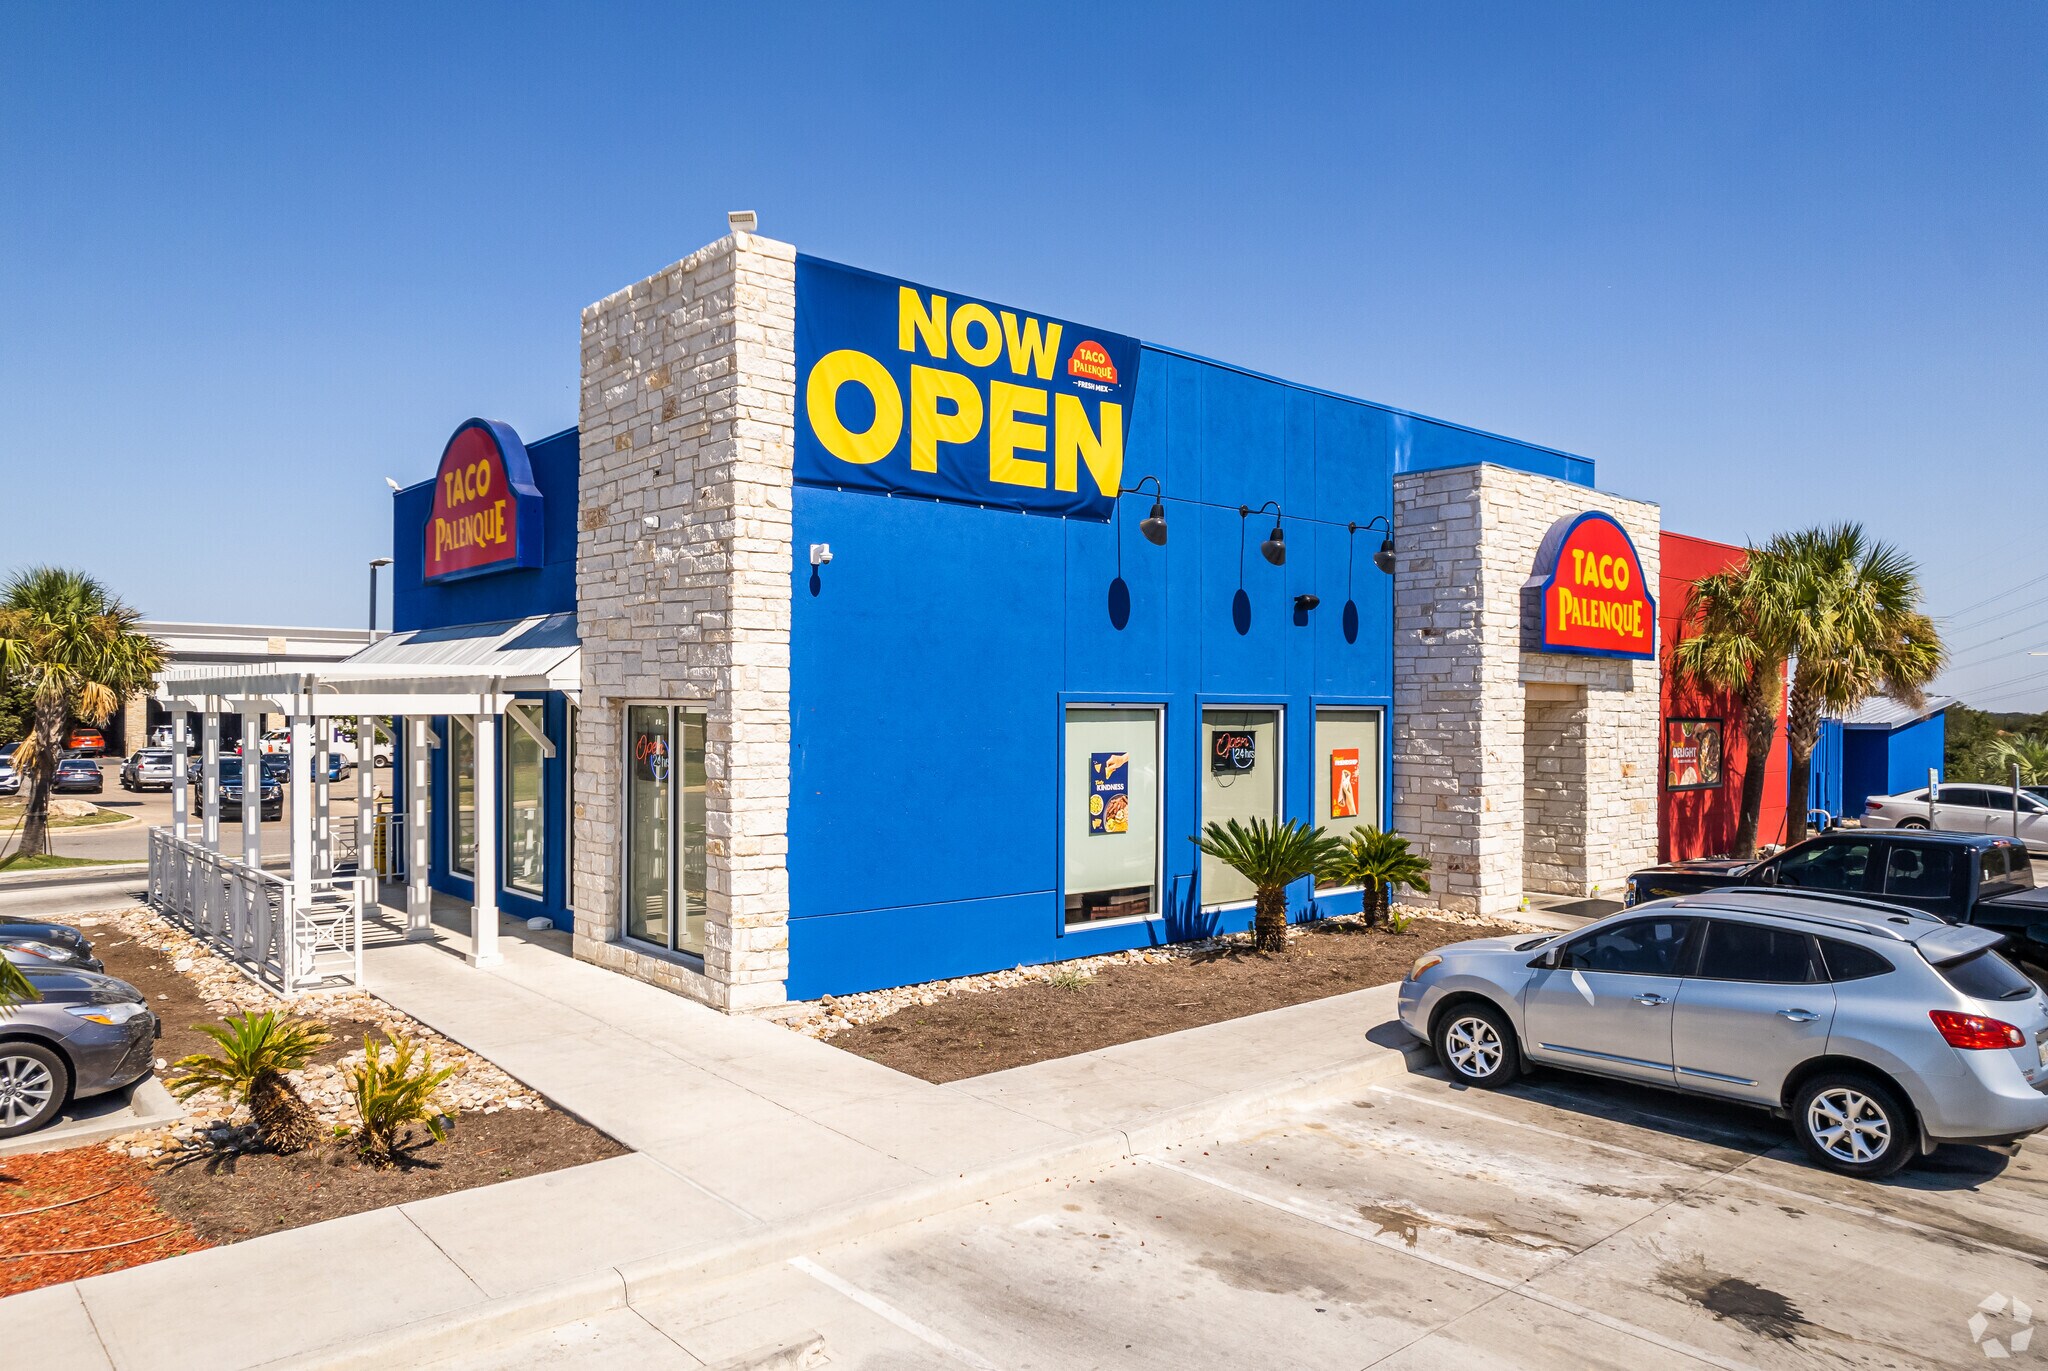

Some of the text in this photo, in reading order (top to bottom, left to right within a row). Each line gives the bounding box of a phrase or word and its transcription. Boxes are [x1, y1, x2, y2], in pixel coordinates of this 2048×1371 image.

[898, 285, 1063, 381] NOW
[1073, 358, 1113, 379] PALENQUE
[1080, 348, 1106, 364] TACO
[1077, 380, 1109, 393] FRESH MEX
[806, 349, 1123, 498] OPEN
[444, 458, 492, 509] TACO
[435, 499, 508, 562] PALENQUE
[1572, 548, 1630, 591] TACO
[1558, 587, 1644, 638] PALENQUE
[635, 735, 664, 765] Open
[1216, 733, 1249, 759] Open
[1234, 748, 1255, 759] 24hrs
[1672, 747, 1697, 758] DELIGHT
[1096, 784, 1125, 792] KINDNESS
